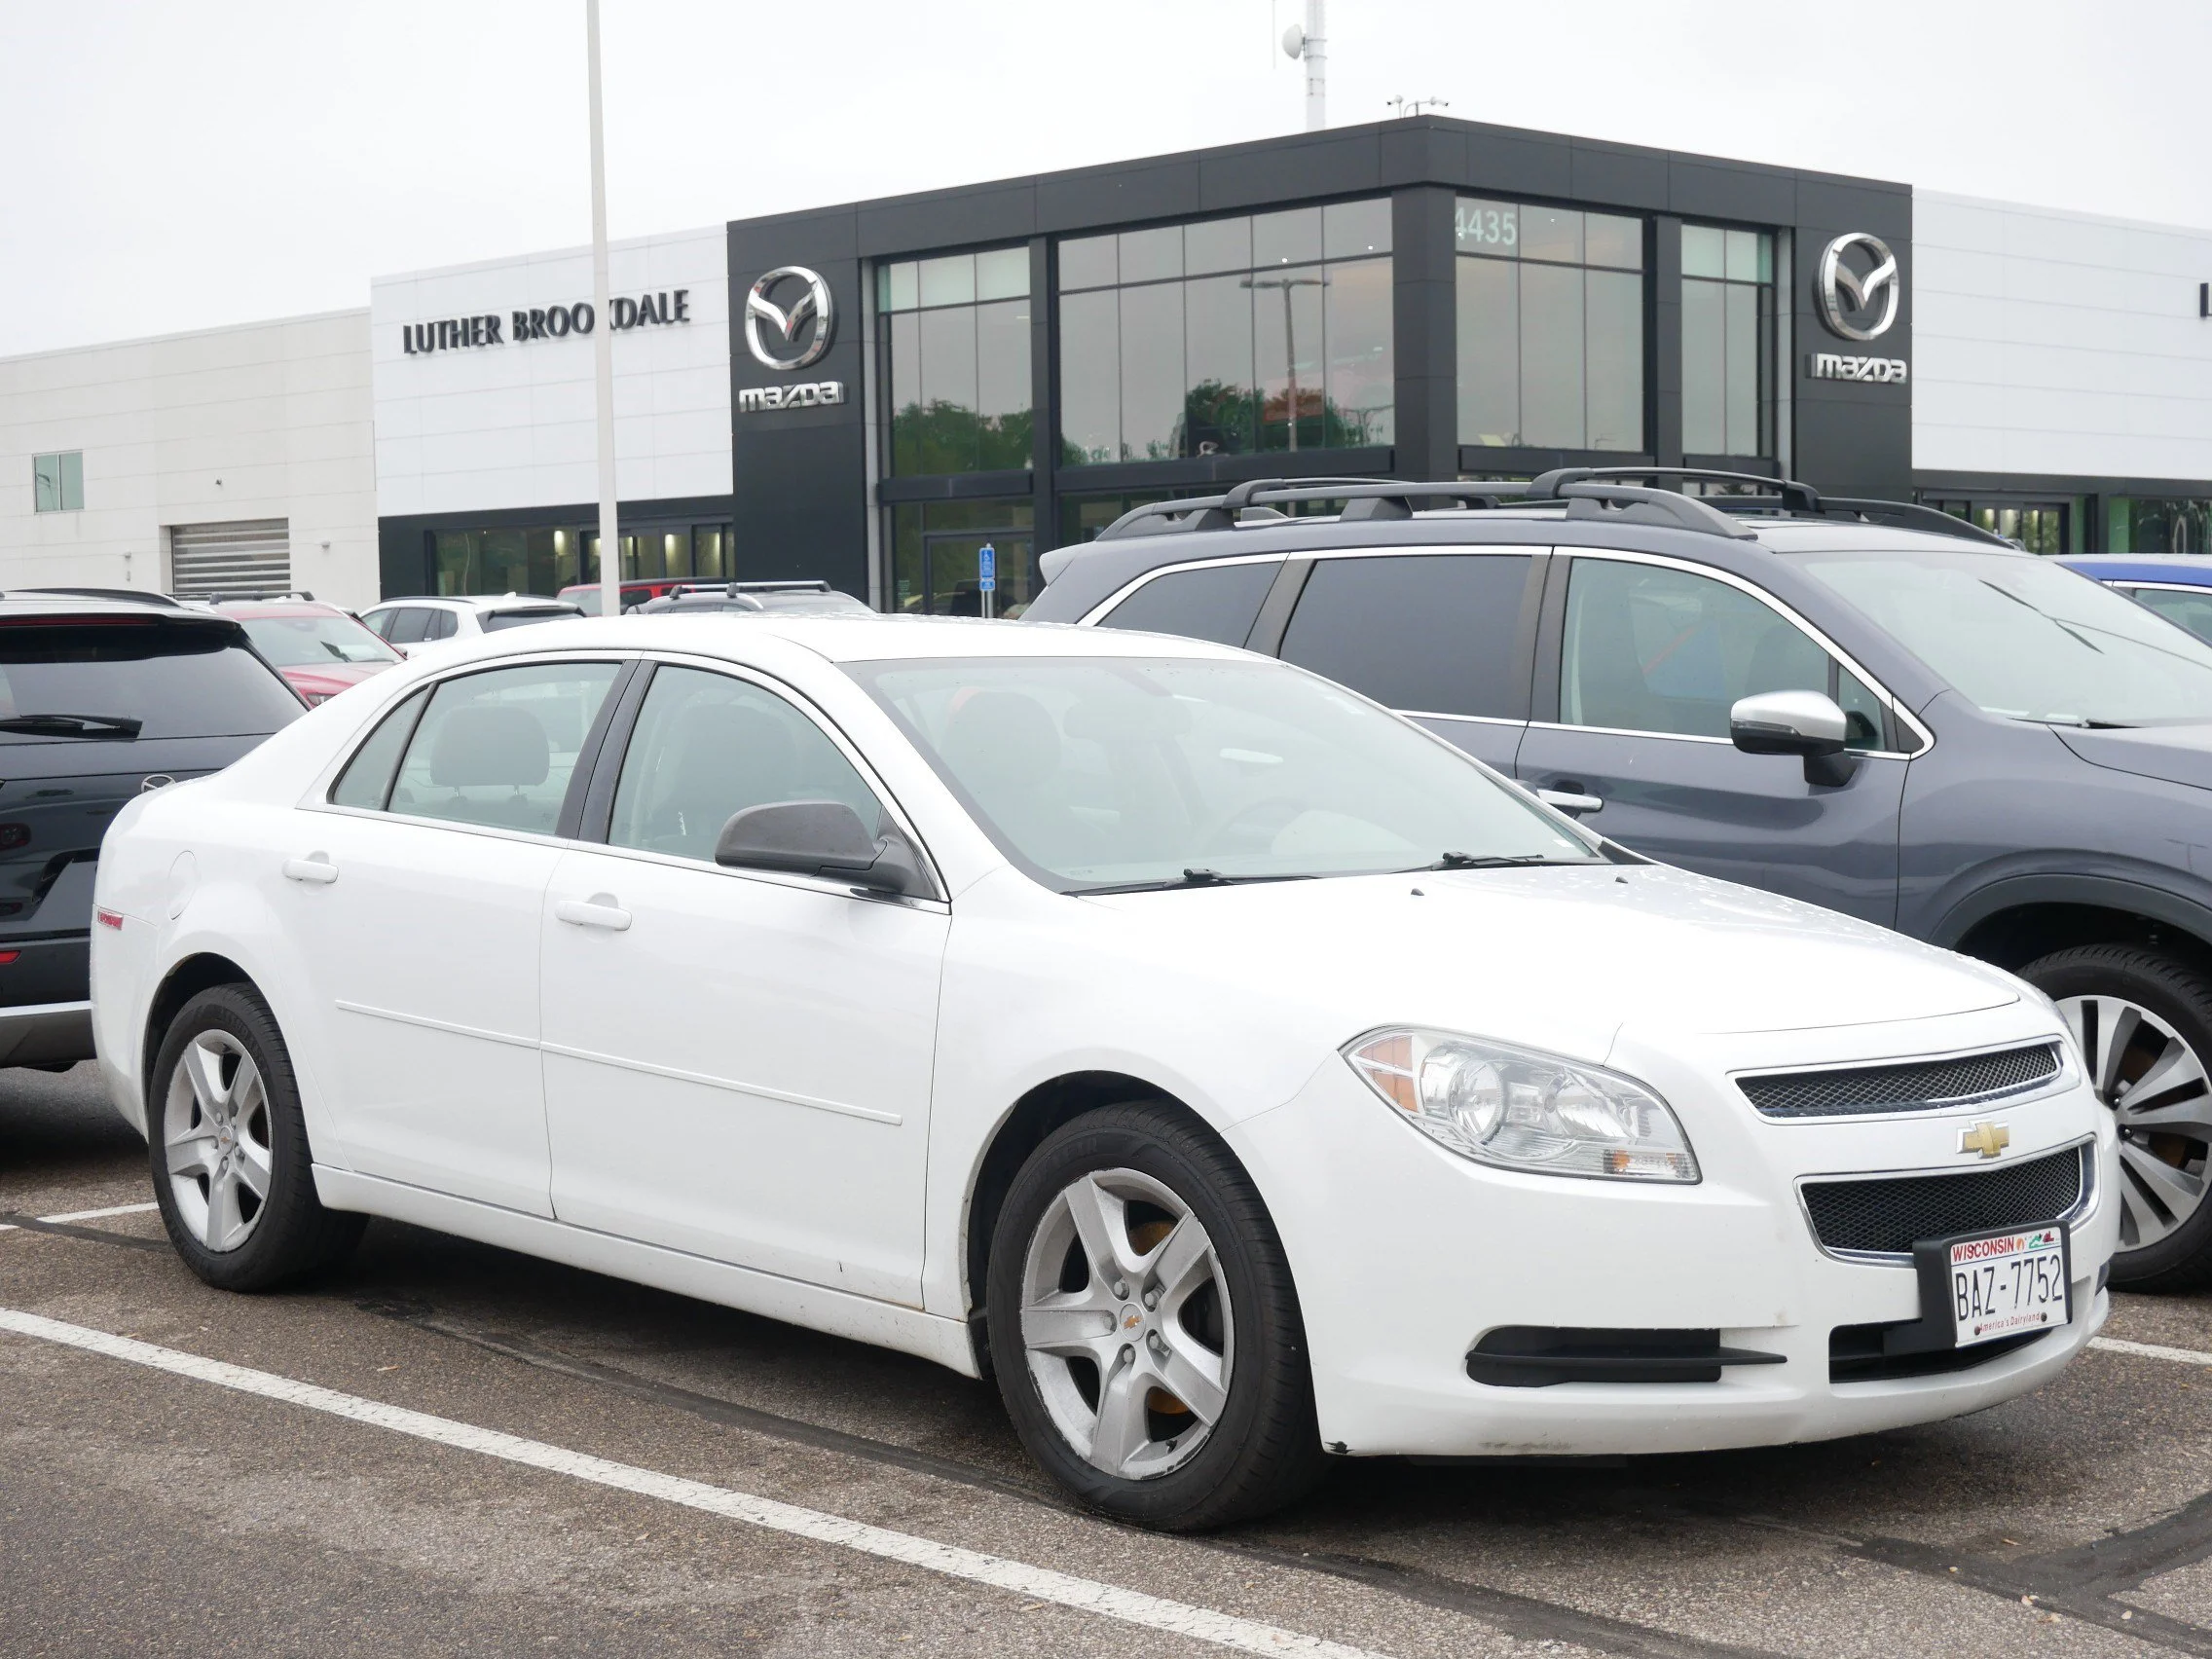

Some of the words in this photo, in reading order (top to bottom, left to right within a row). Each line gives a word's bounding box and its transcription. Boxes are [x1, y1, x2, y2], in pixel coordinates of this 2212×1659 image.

[1455, 207, 1517, 245] 4435
[403, 314, 504, 354] LUTHER
[1952, 1236, 2014, 1262] WISCONSIN
[1955, 1254, 2063, 1321] BAZ-7752
